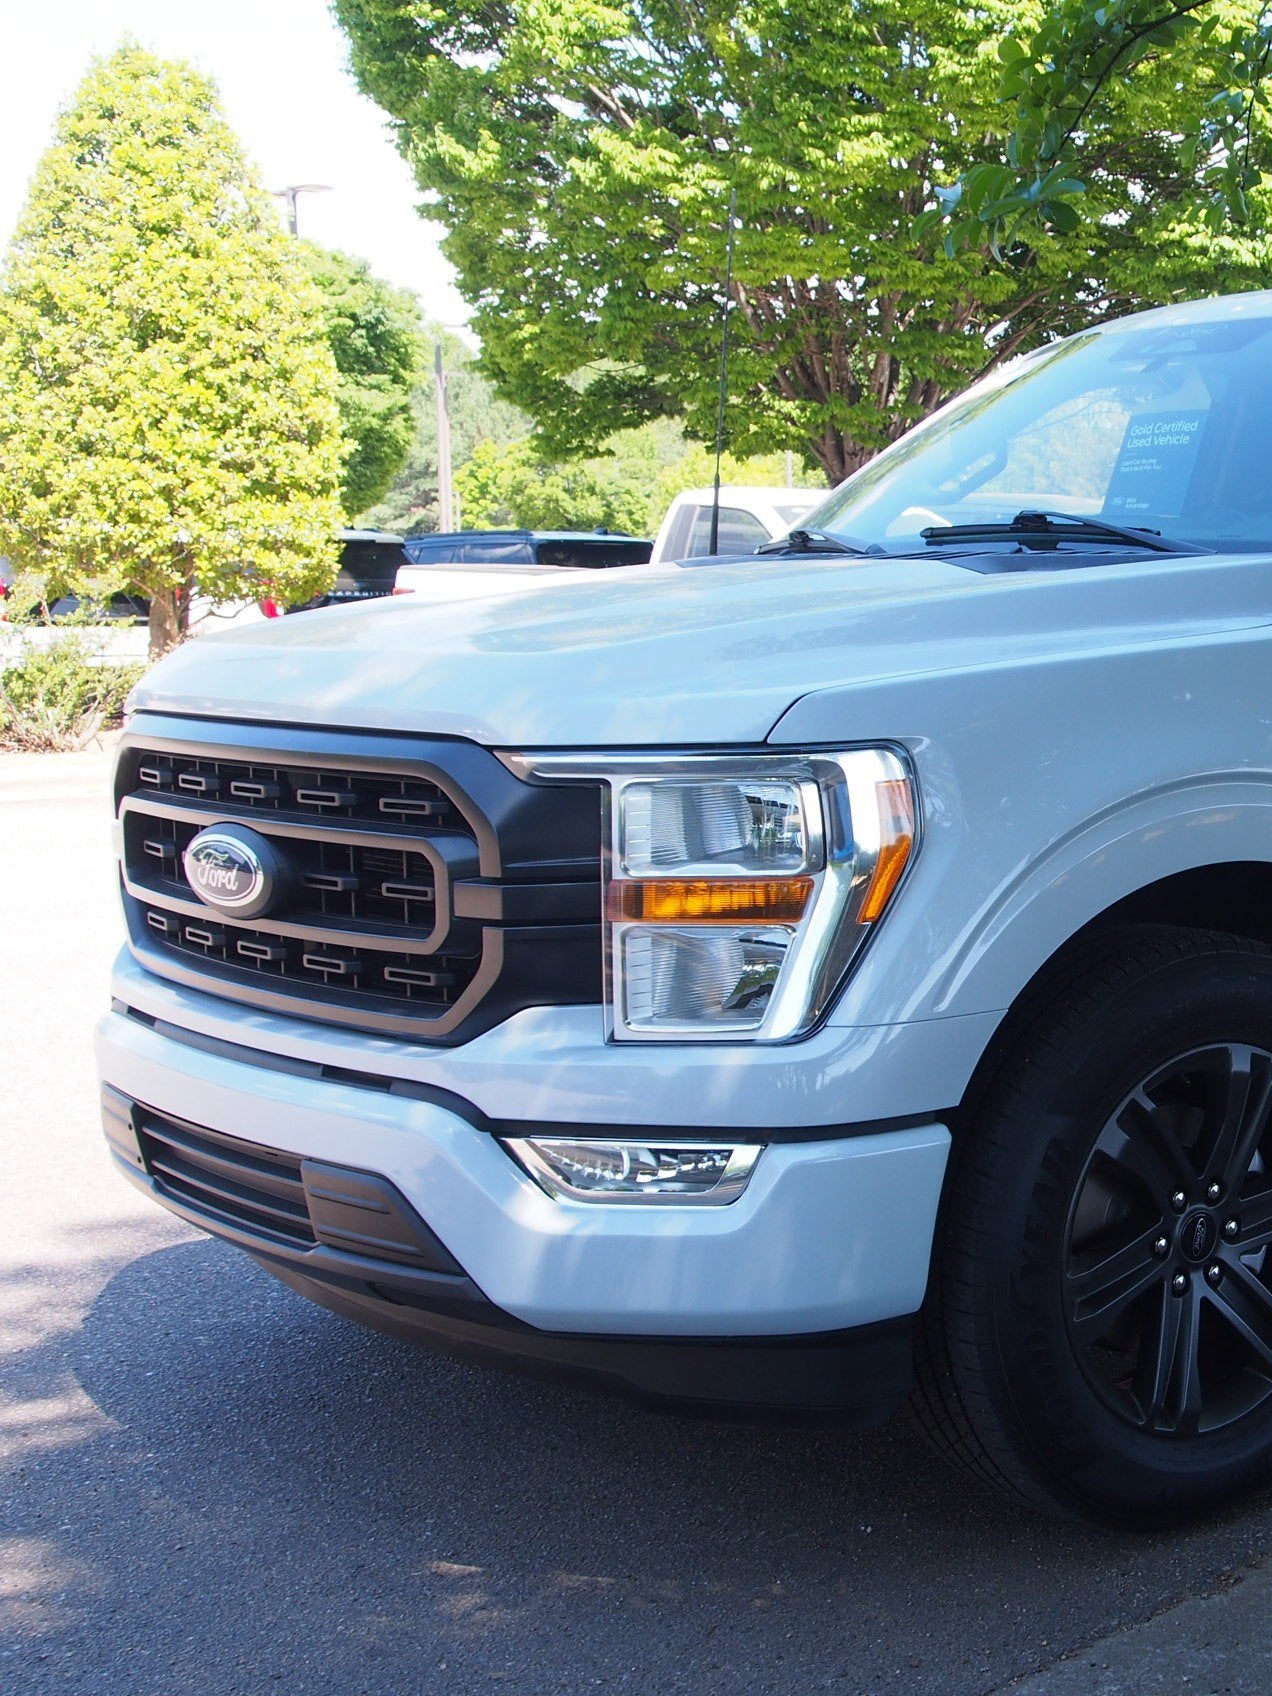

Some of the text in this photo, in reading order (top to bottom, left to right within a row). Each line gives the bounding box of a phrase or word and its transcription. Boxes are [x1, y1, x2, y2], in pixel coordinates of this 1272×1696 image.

[1130, 420, 1199, 436] Gold Certified
[1126, 434, 1190, 448] Used Vehicle
[327, 590, 392, 598] EXPEDITIO
[198, 848, 239, 891] Ford
